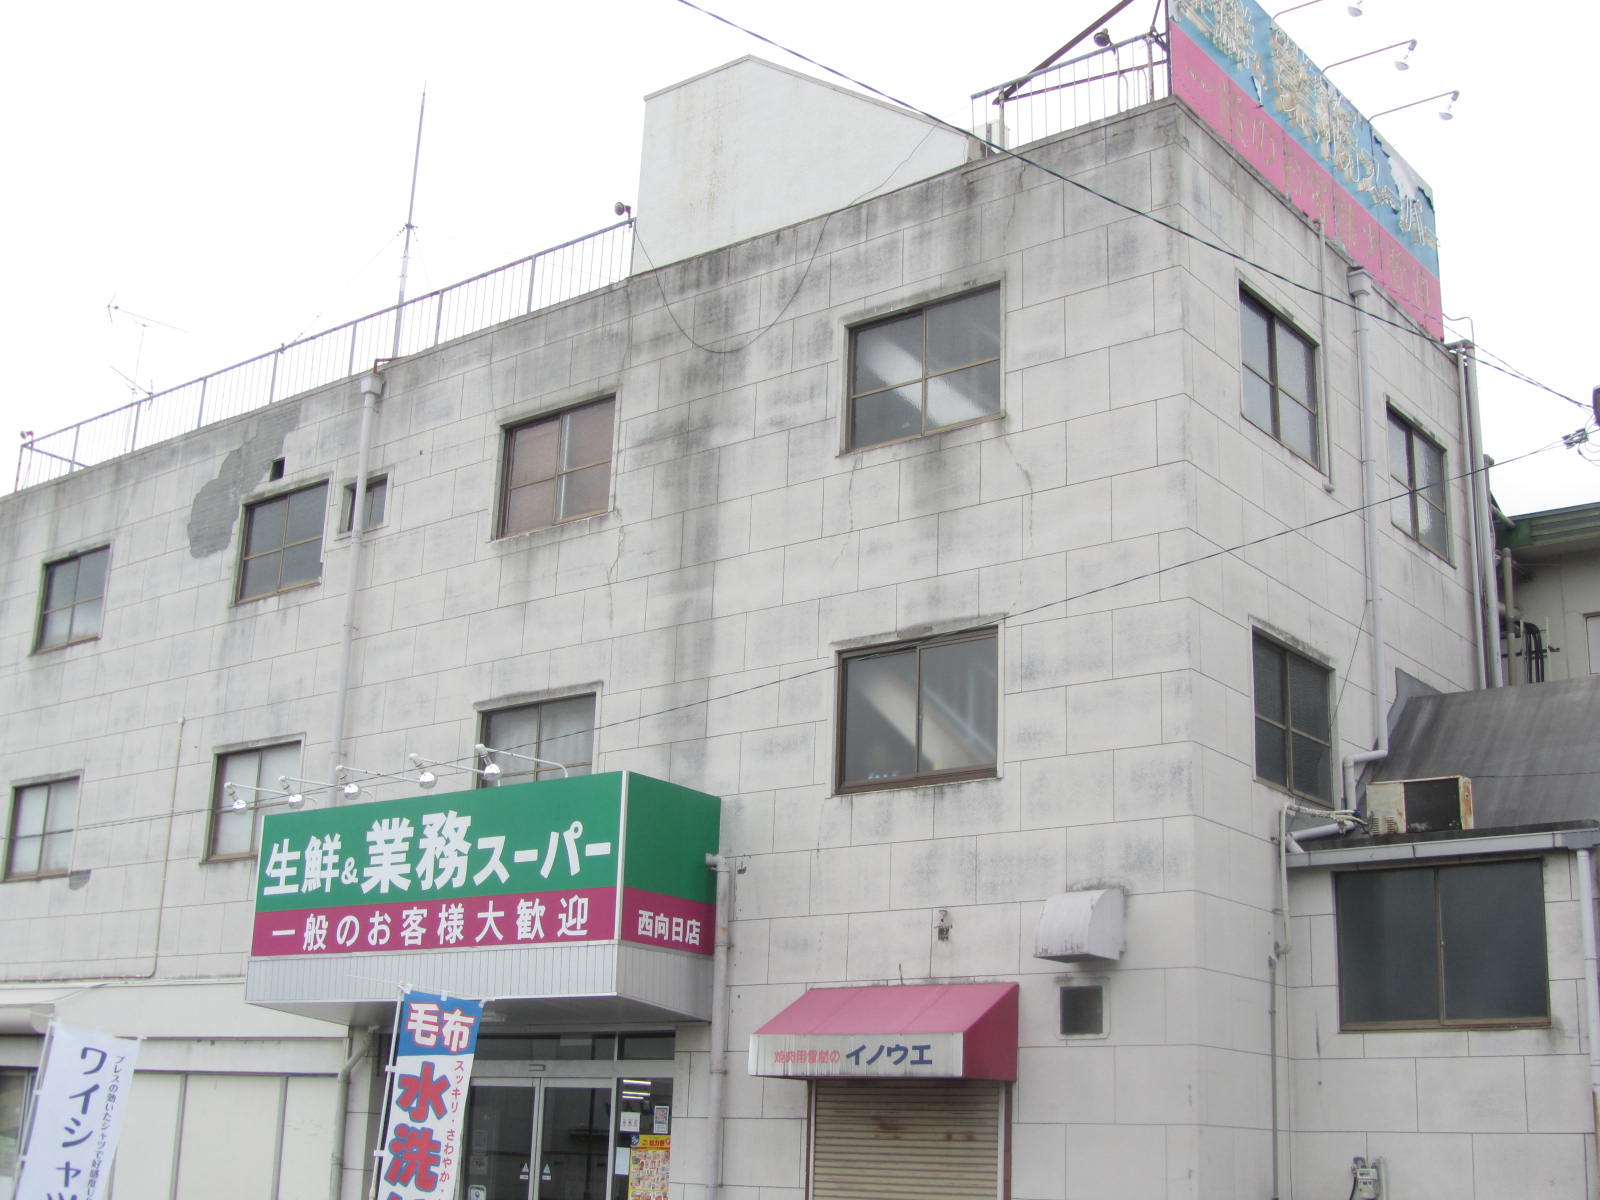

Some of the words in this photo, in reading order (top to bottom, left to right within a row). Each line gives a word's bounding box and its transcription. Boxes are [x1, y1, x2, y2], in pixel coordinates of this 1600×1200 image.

[263, 810, 612, 896] 生鮮&業務スーパー
[271, 894, 590, 951] 一般のお客様大歓迎
[637, 909, 702, 946] 西向日店
[406, 1001, 476, 1054] 毛布
[845, 1044, 933, 1066] イノウエ
[382, 1060, 452, 1200] 水洗
